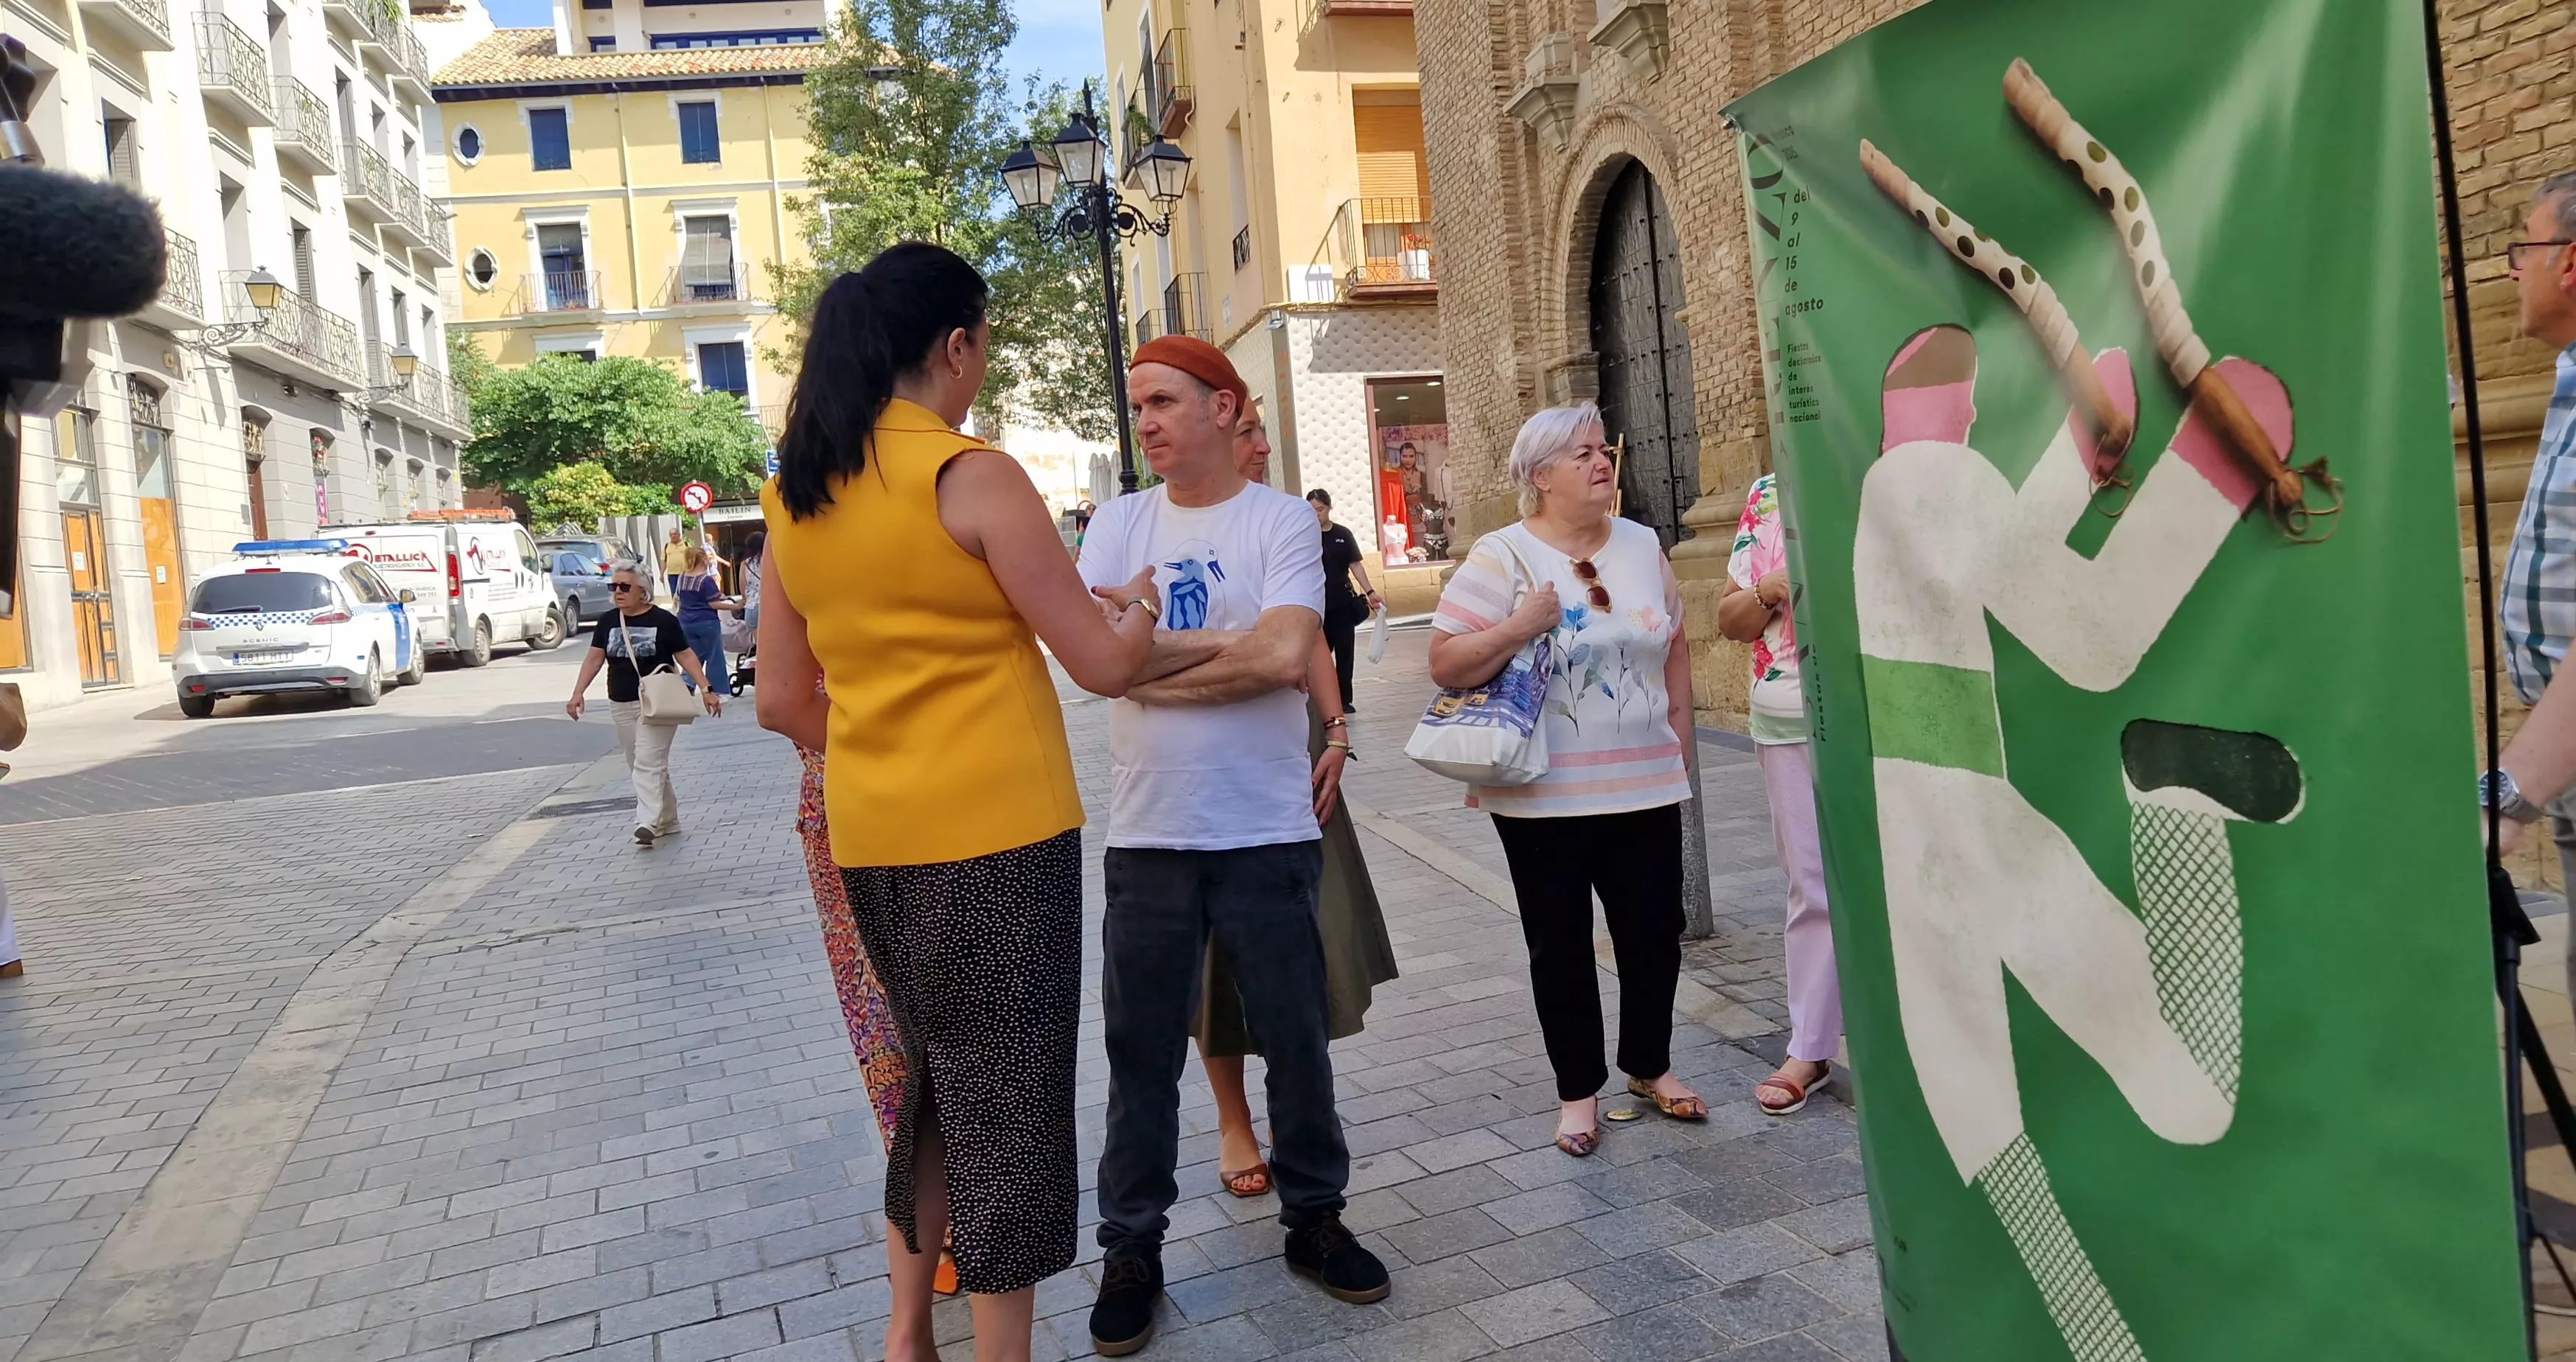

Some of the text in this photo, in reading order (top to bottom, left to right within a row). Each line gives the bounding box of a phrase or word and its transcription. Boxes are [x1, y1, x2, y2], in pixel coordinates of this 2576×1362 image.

[1794, 185, 1810, 203] del
[1791, 212, 1798, 226] 9
[1787, 232, 1800, 248] al
[1786, 256, 1797, 270] 15
[1784, 278, 1797, 293] de
[1785, 298, 1823, 318] agosto
[1787, 343, 1809, 354] Fiestas
[1788, 371, 1797, 381] de
[1789, 383, 1813, 395] interés
[1790, 411, 1821, 423] nacional
